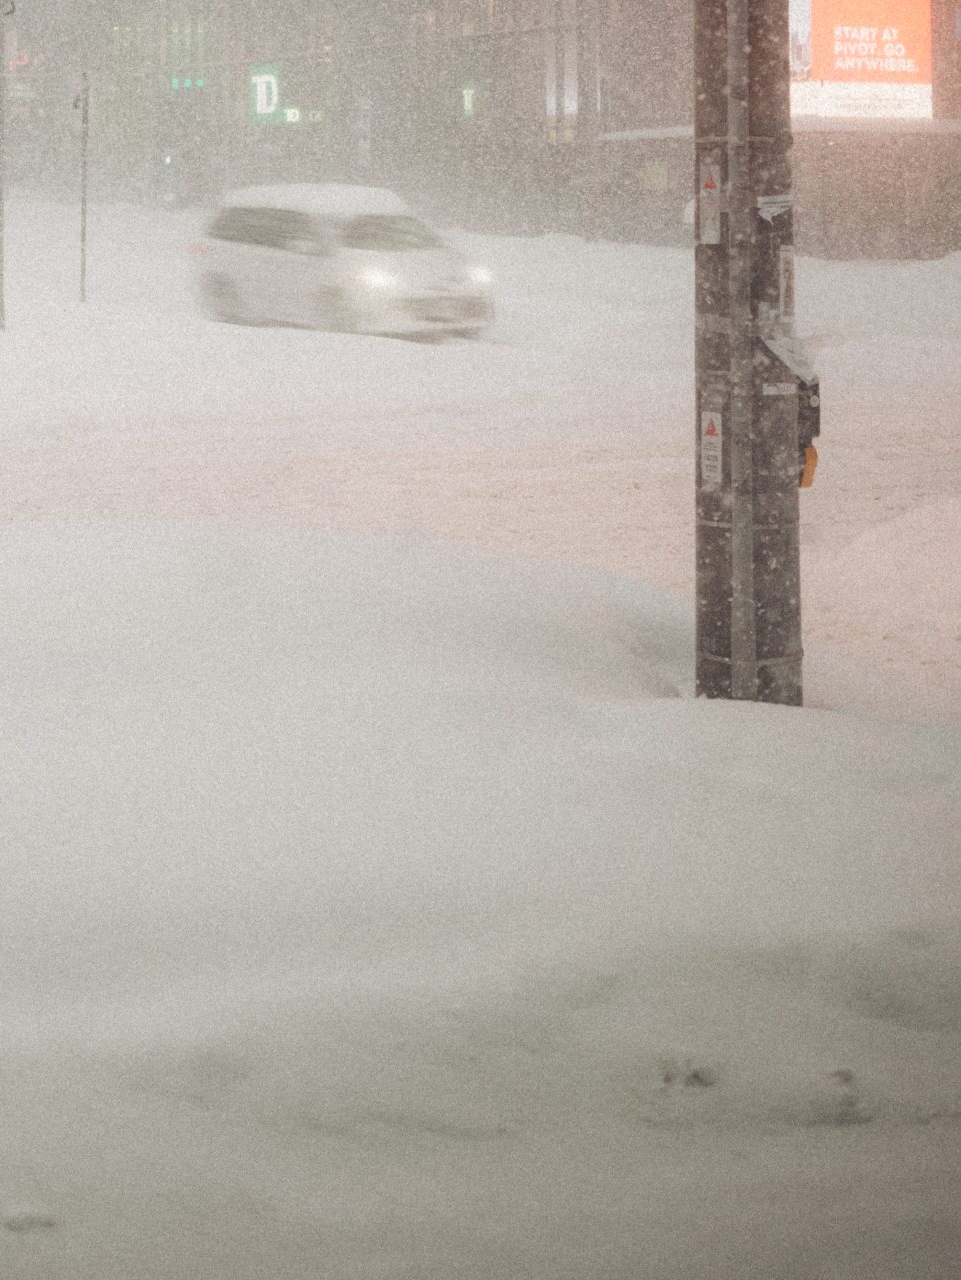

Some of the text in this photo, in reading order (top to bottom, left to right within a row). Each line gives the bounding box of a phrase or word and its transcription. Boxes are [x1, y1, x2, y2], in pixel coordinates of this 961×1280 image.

[834, 26, 899, 41] START AT
[884, 43, 906, 57] GO
